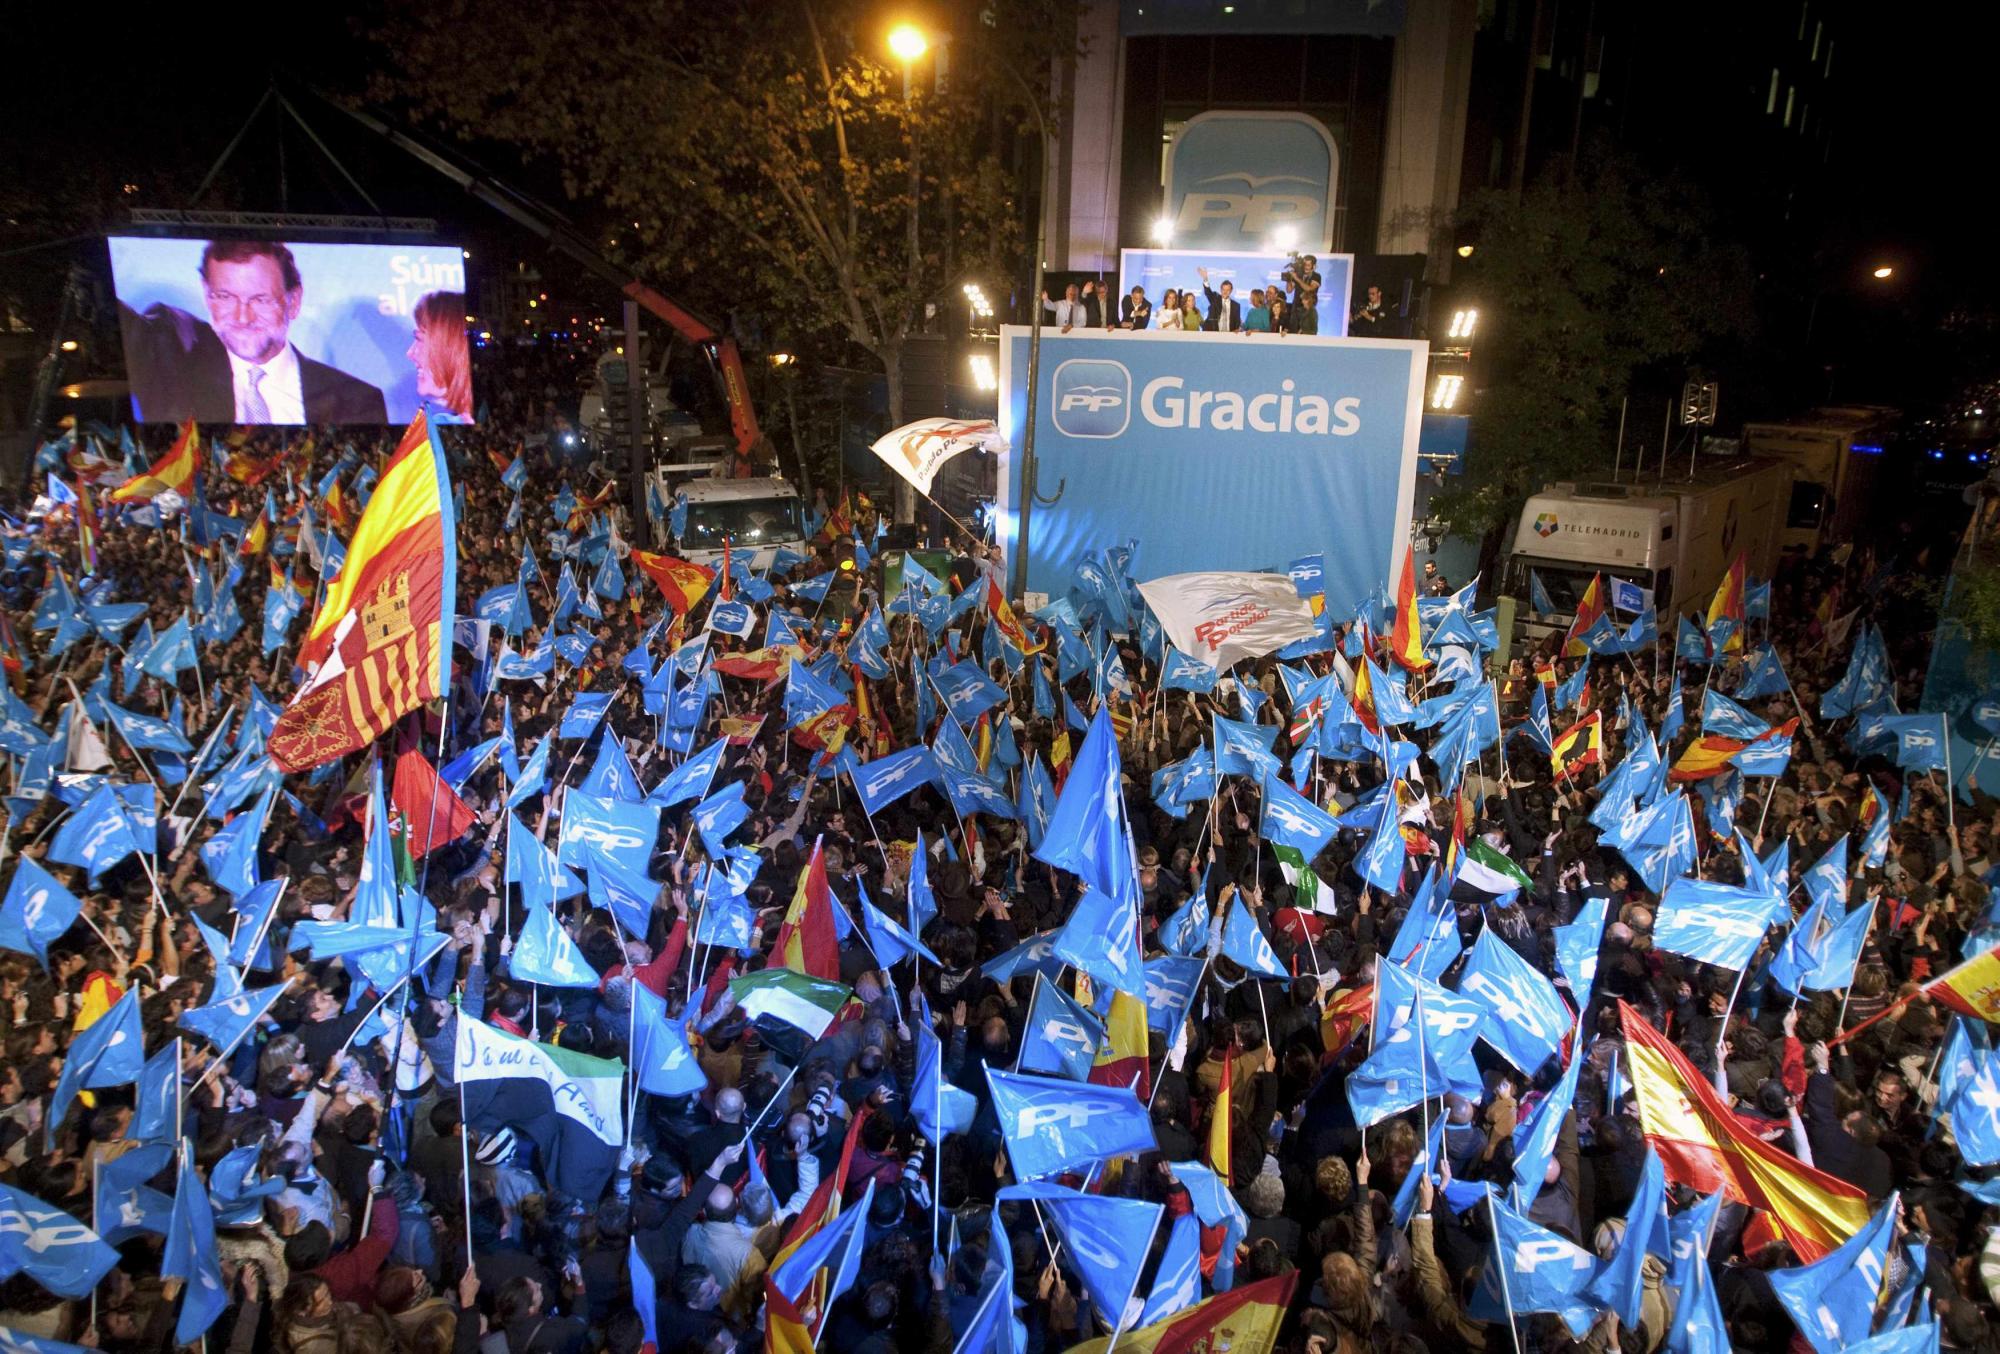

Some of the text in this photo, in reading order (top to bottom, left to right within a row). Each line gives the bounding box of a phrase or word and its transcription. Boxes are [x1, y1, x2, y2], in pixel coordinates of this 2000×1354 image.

[1175, 193, 1320, 232] PP
[1059, 394, 1122, 412] PP
[1141, 376, 1361, 436] Gracias
[1563, 523, 1641, 539] TELEMADRID
[1194, 602, 1257, 643] Partido
[1207, 607, 1271, 651] Popular
[949, 682, 985, 708] PP
[1904, 734, 1936, 749] PP
[866, 756, 922, 798] PP
[1267, 803, 1321, 837] PP
[563, 826, 644, 850] PP
[1672, 909, 1764, 937] PP
[1390, 1004, 1479, 1037] PP
[1462, 971, 1545, 1039] PP
[1017, 1100, 1126, 1139] PP
